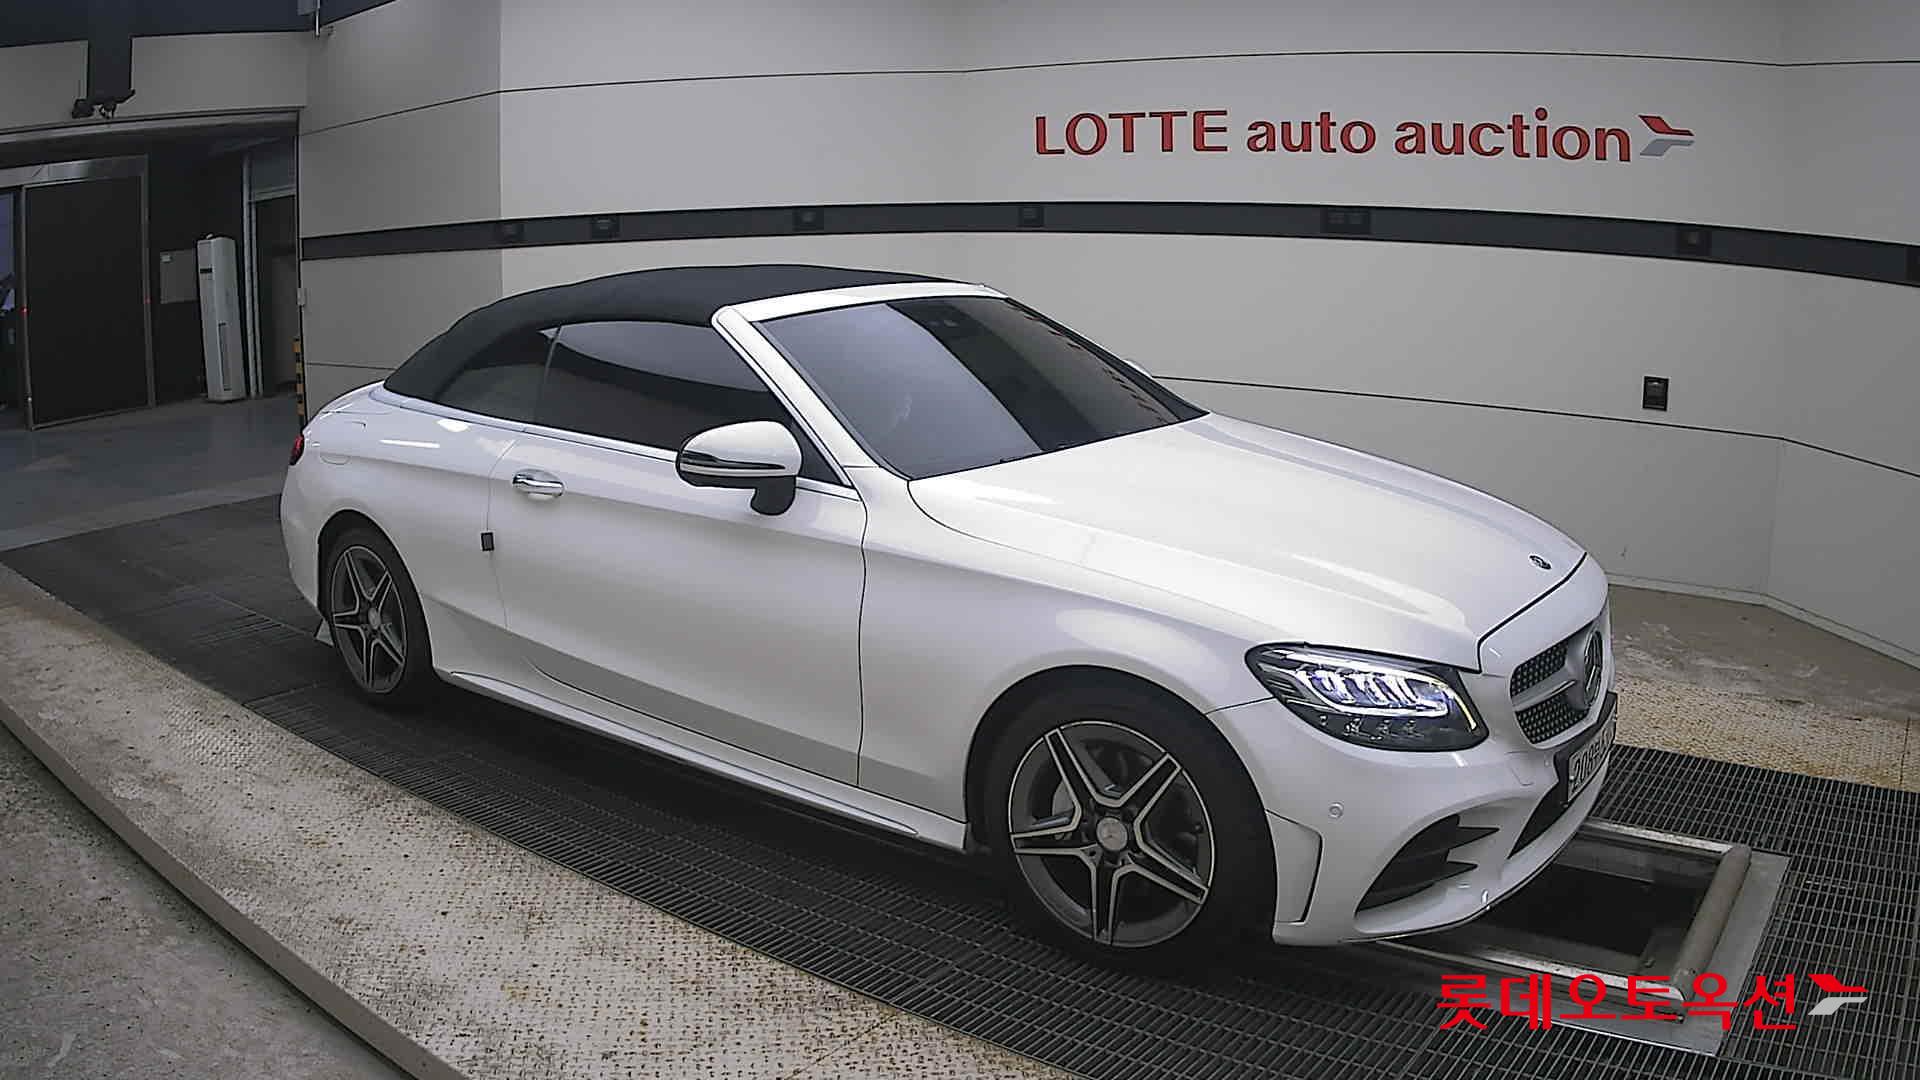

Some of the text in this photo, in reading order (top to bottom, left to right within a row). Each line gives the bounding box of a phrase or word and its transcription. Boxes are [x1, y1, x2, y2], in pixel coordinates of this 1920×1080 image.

[1035, 107, 1632, 163] LOTTE auto auction
